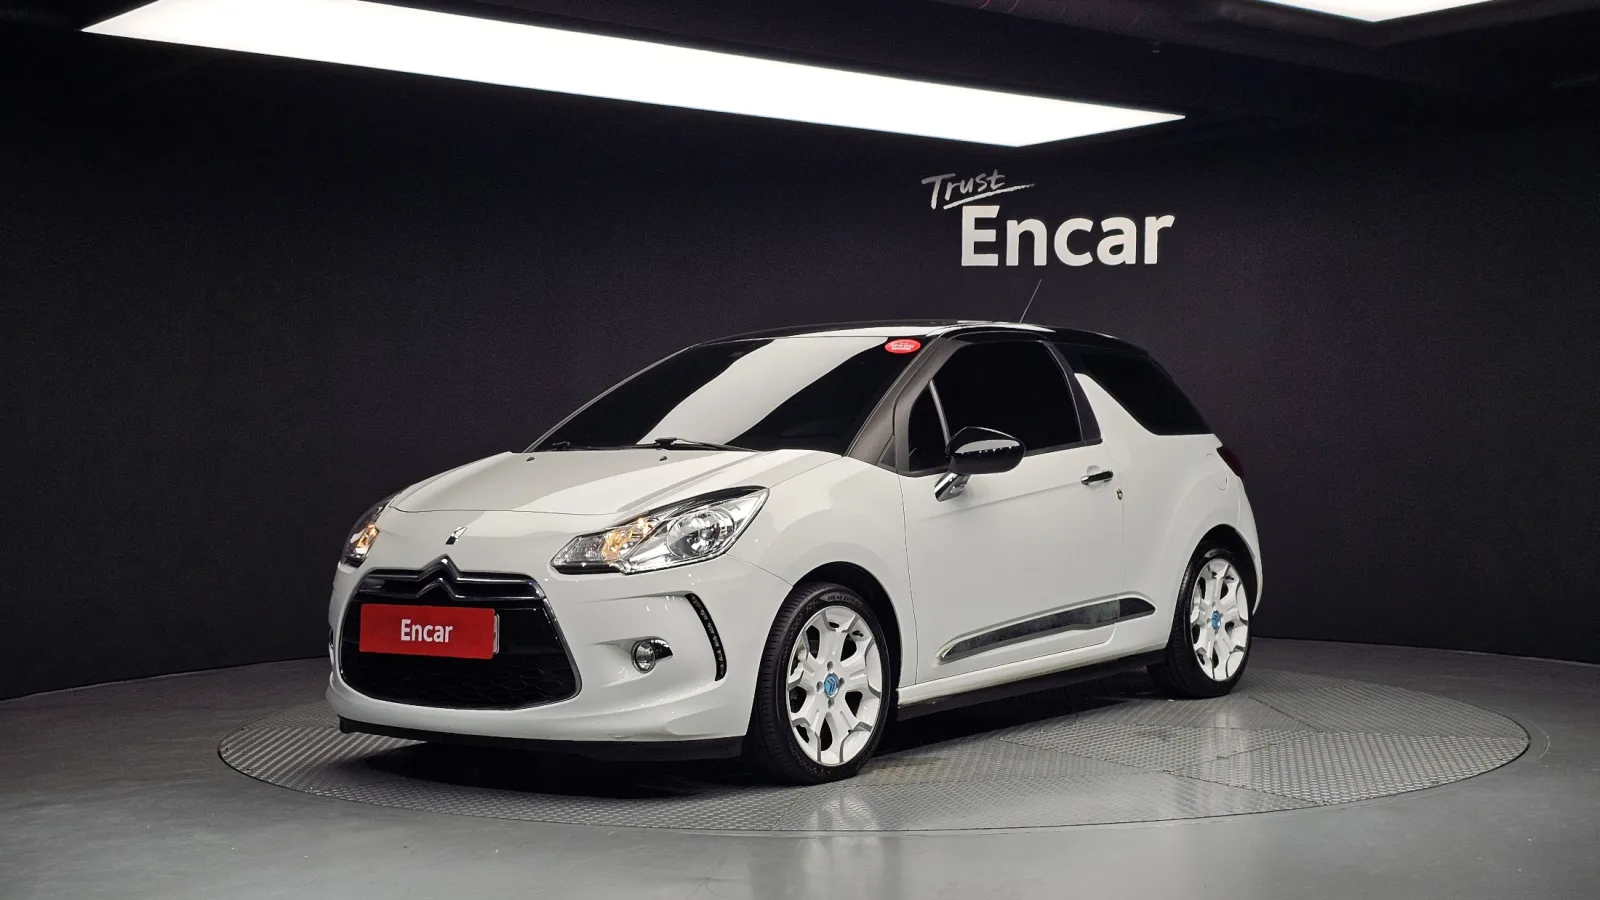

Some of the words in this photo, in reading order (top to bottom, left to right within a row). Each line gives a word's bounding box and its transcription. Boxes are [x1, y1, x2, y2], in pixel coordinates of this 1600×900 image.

[921, 169, 1006, 210] Trust
[961, 205, 1175, 266] Encar
[400, 619, 454, 643] Encar
